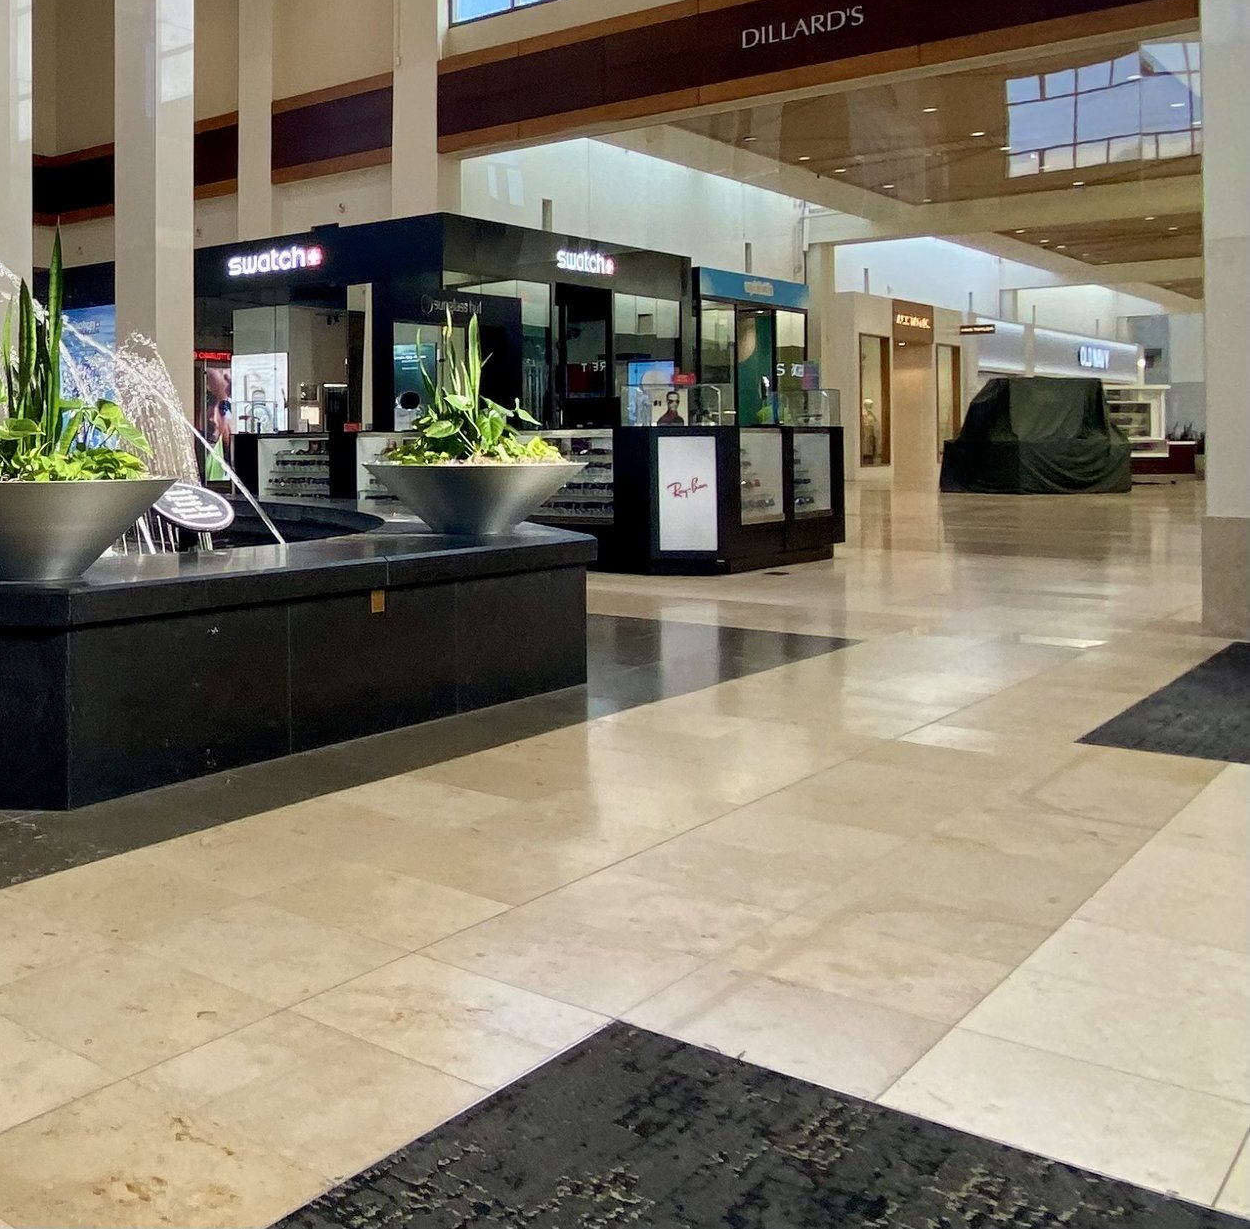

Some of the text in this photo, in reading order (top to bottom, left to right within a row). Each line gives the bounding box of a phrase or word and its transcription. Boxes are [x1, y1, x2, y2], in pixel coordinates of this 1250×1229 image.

[741, 5, 864, 49] DILLARD'S
[227, 246, 307, 276] swatch
[556, 250, 606, 274] swatch
[667, 477, 708, 498] Ray-Ban
